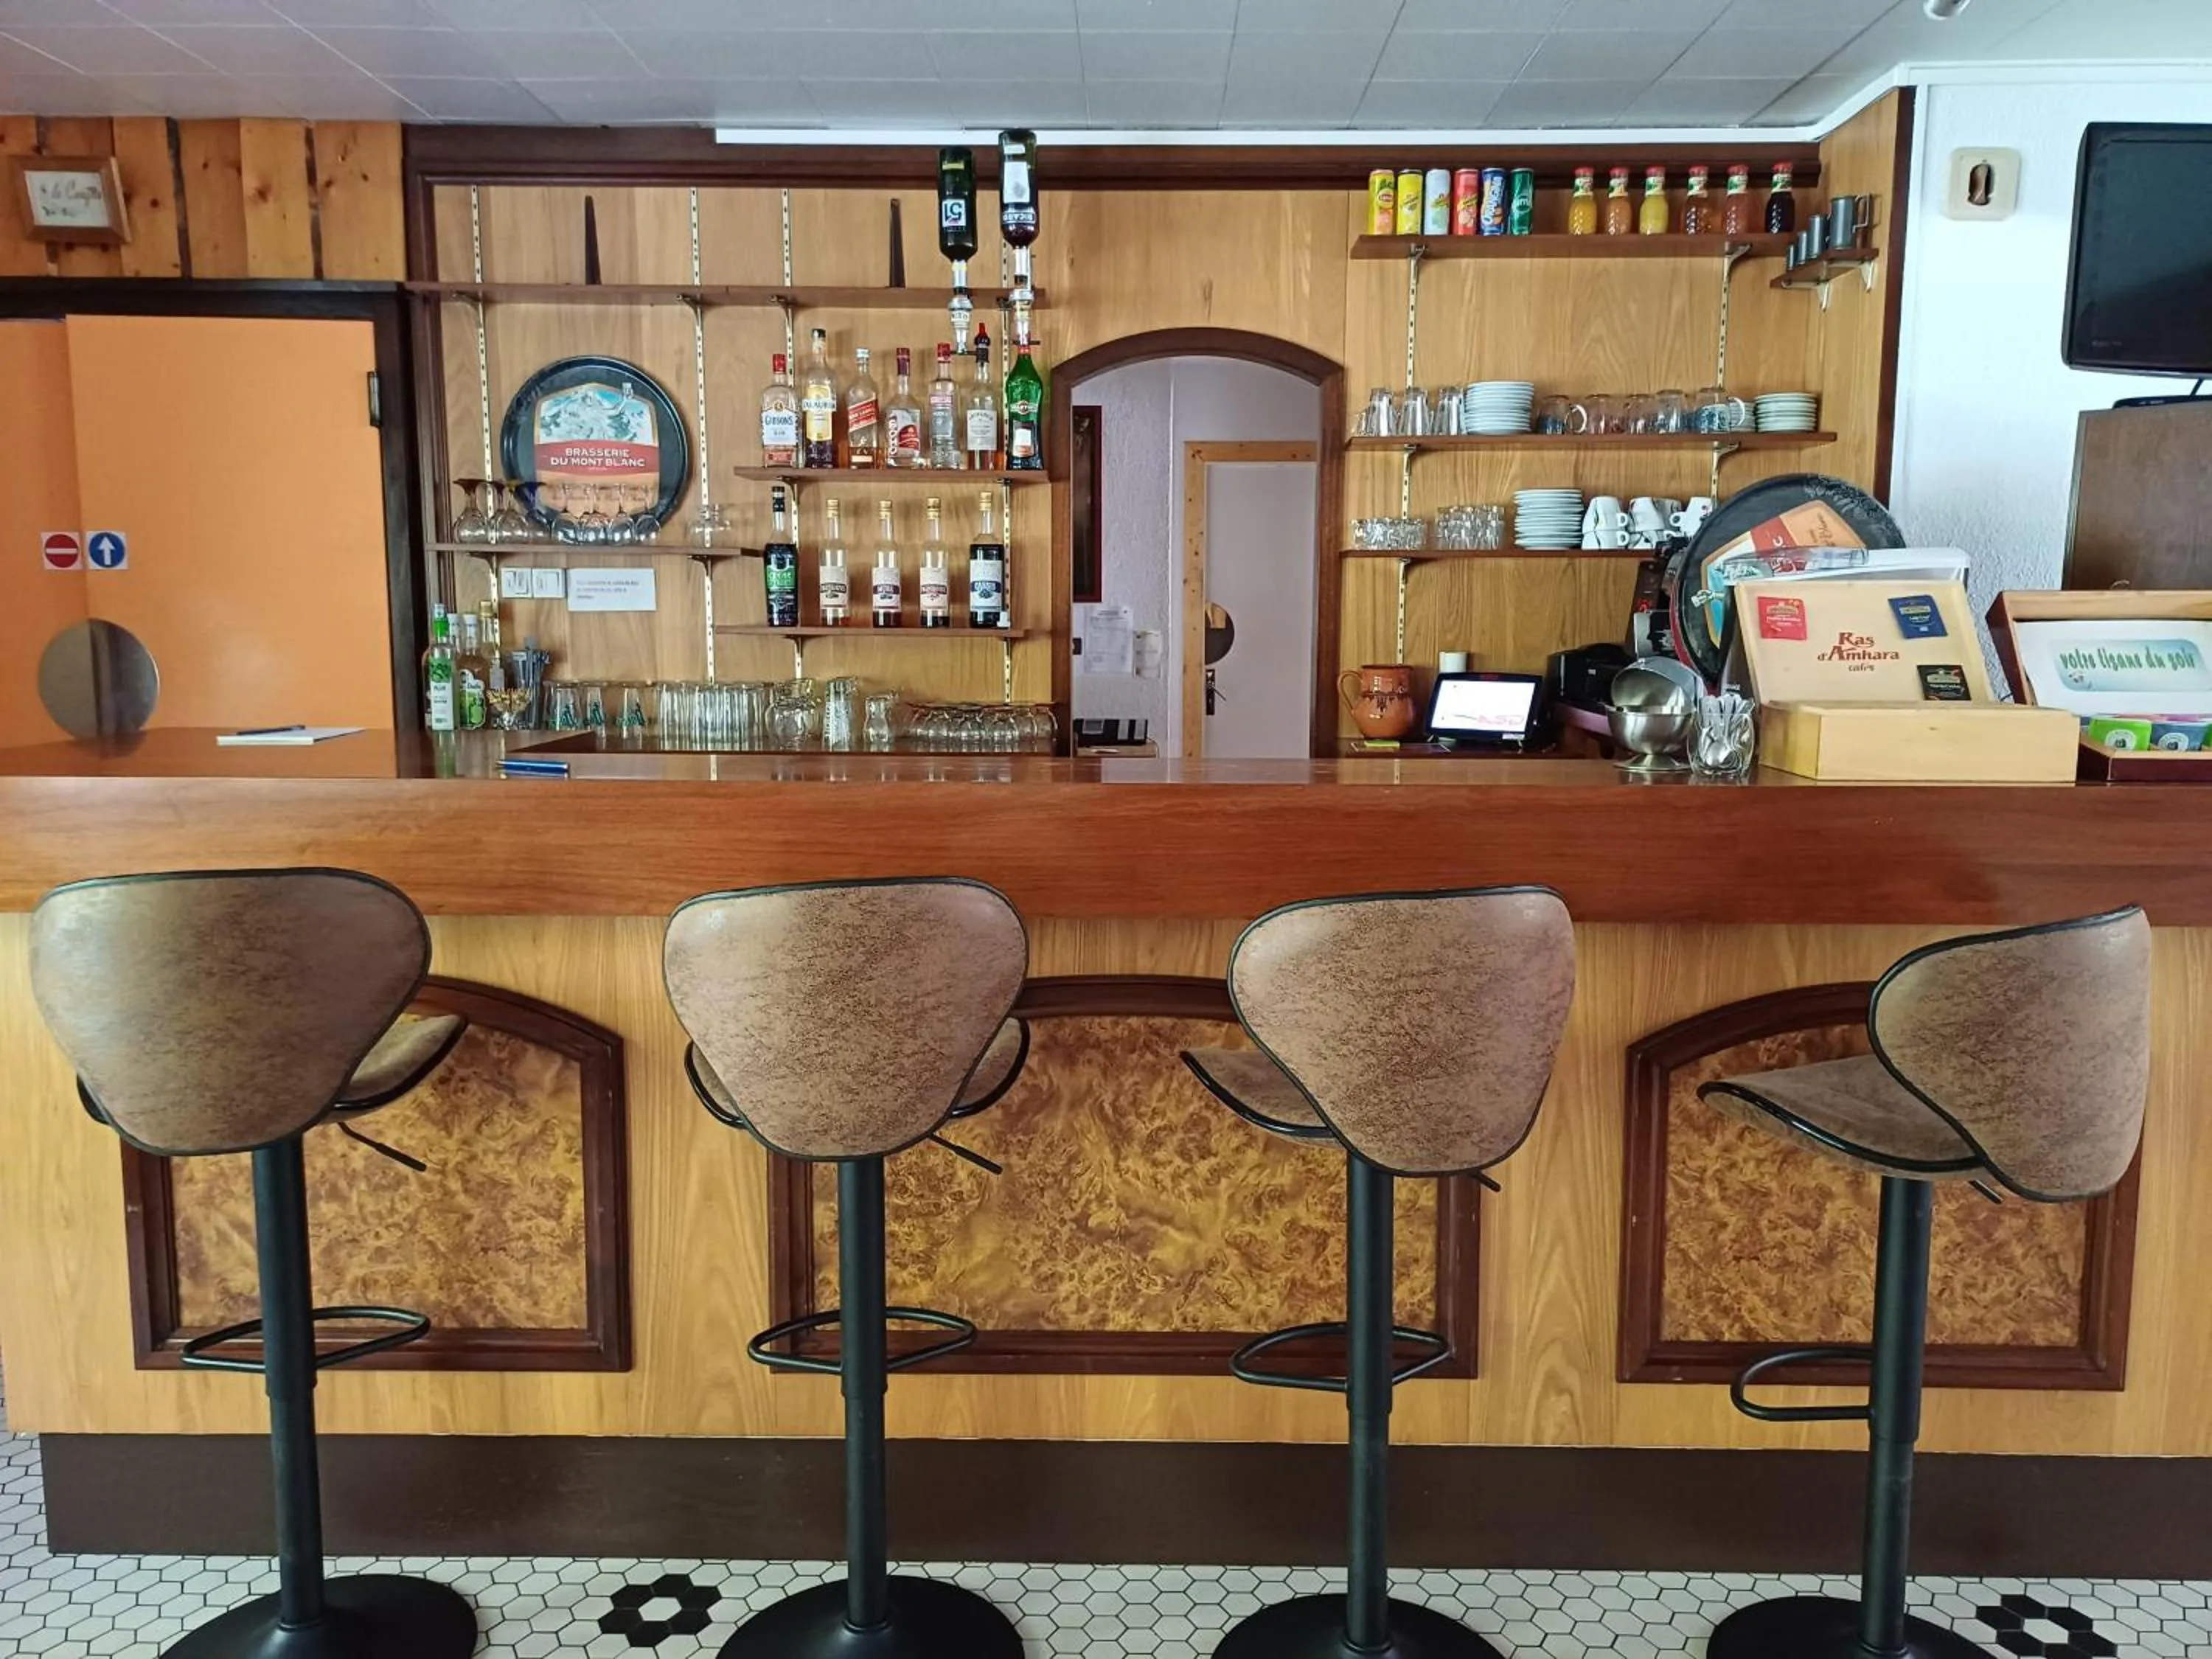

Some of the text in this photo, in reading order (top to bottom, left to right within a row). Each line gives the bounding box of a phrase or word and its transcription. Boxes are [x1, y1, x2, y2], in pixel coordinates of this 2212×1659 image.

[945, 202, 962, 222] 51
[566, 448, 630, 457] BRASSERIE
[550, 457, 646, 467] DU MONT BLANC
[1839, 632, 1875, 647] Ras
[1817, 645, 1900, 661] d'Amhara
[2059, 644, 2196, 672] votre tisane du soir
